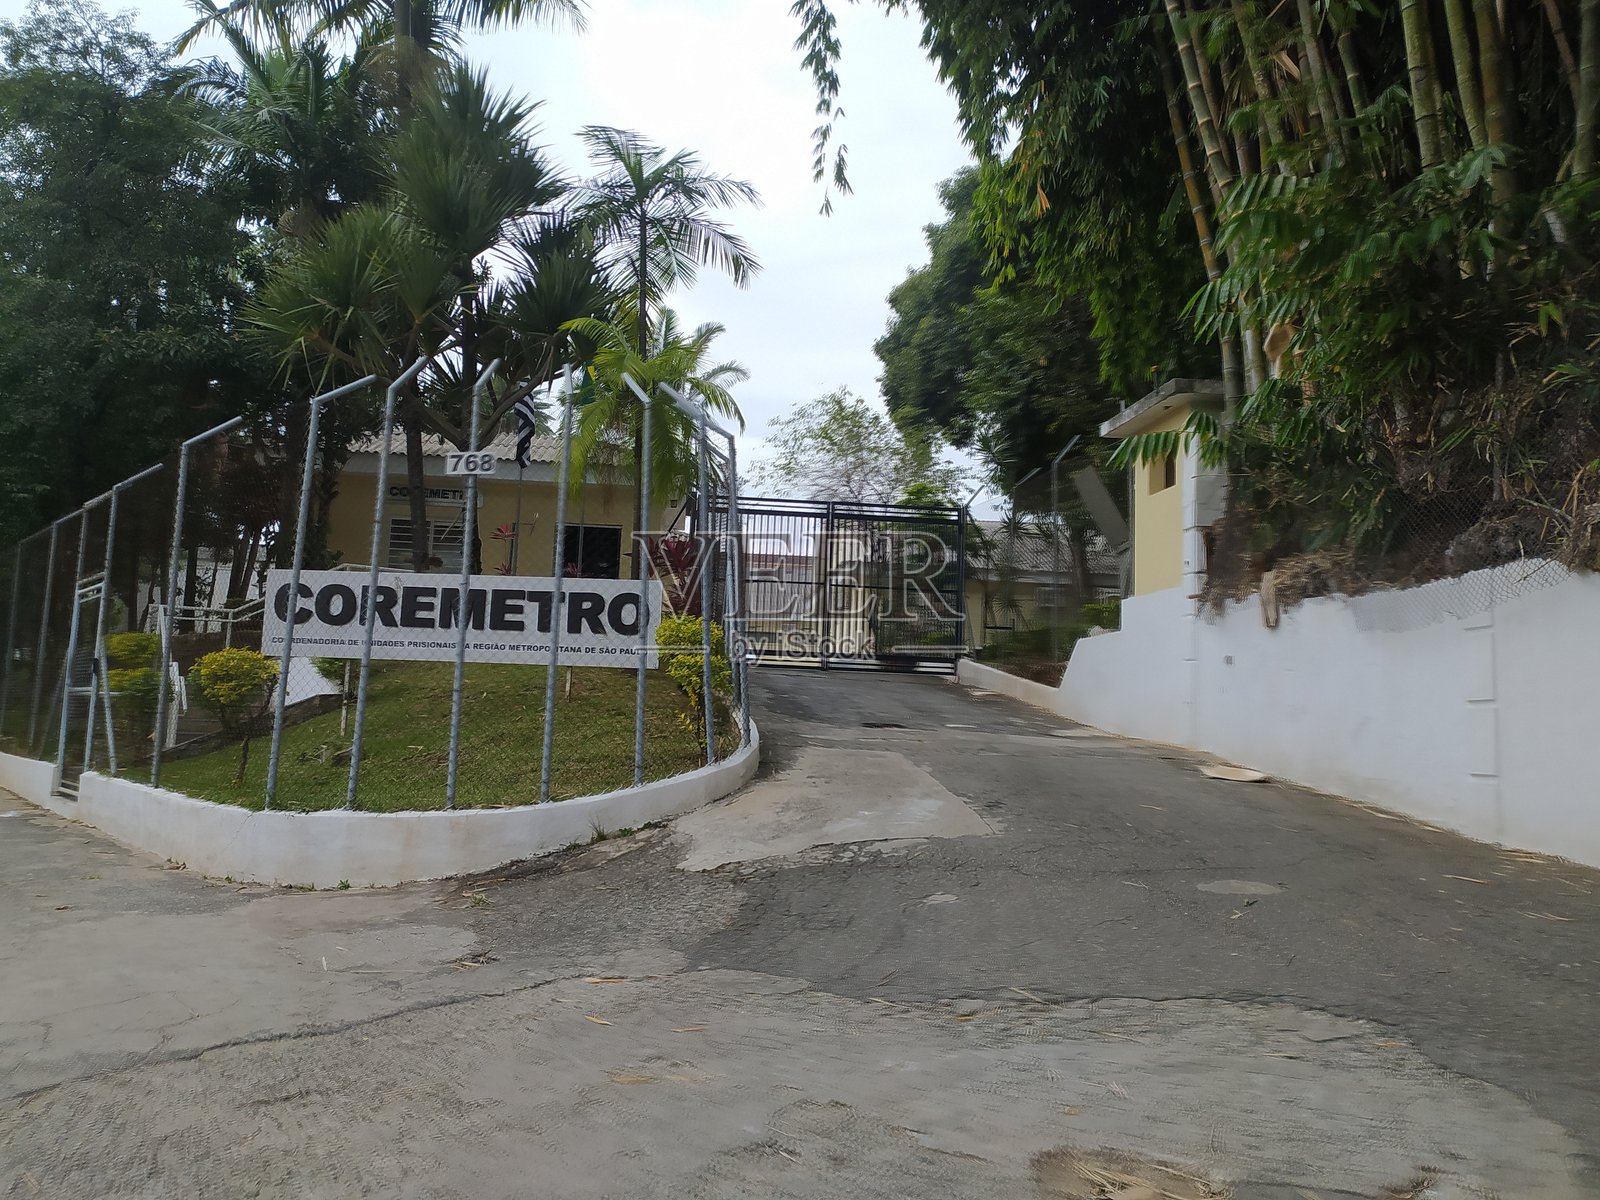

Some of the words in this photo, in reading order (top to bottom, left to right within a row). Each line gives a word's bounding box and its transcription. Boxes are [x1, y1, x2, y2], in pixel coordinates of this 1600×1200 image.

[449, 454, 493, 472] 768
[274, 582, 650, 638] COREMETRO
[272, 636, 345, 646] CORDENADORIA
[347, 639, 359, 647] DE
[407, 641, 457, 650] PRISIONAIS
[473, 642, 506, 652] REGIÃO
[508, 644, 582, 654] METROPOITANA
[598, 646, 617, 655] SÃO
